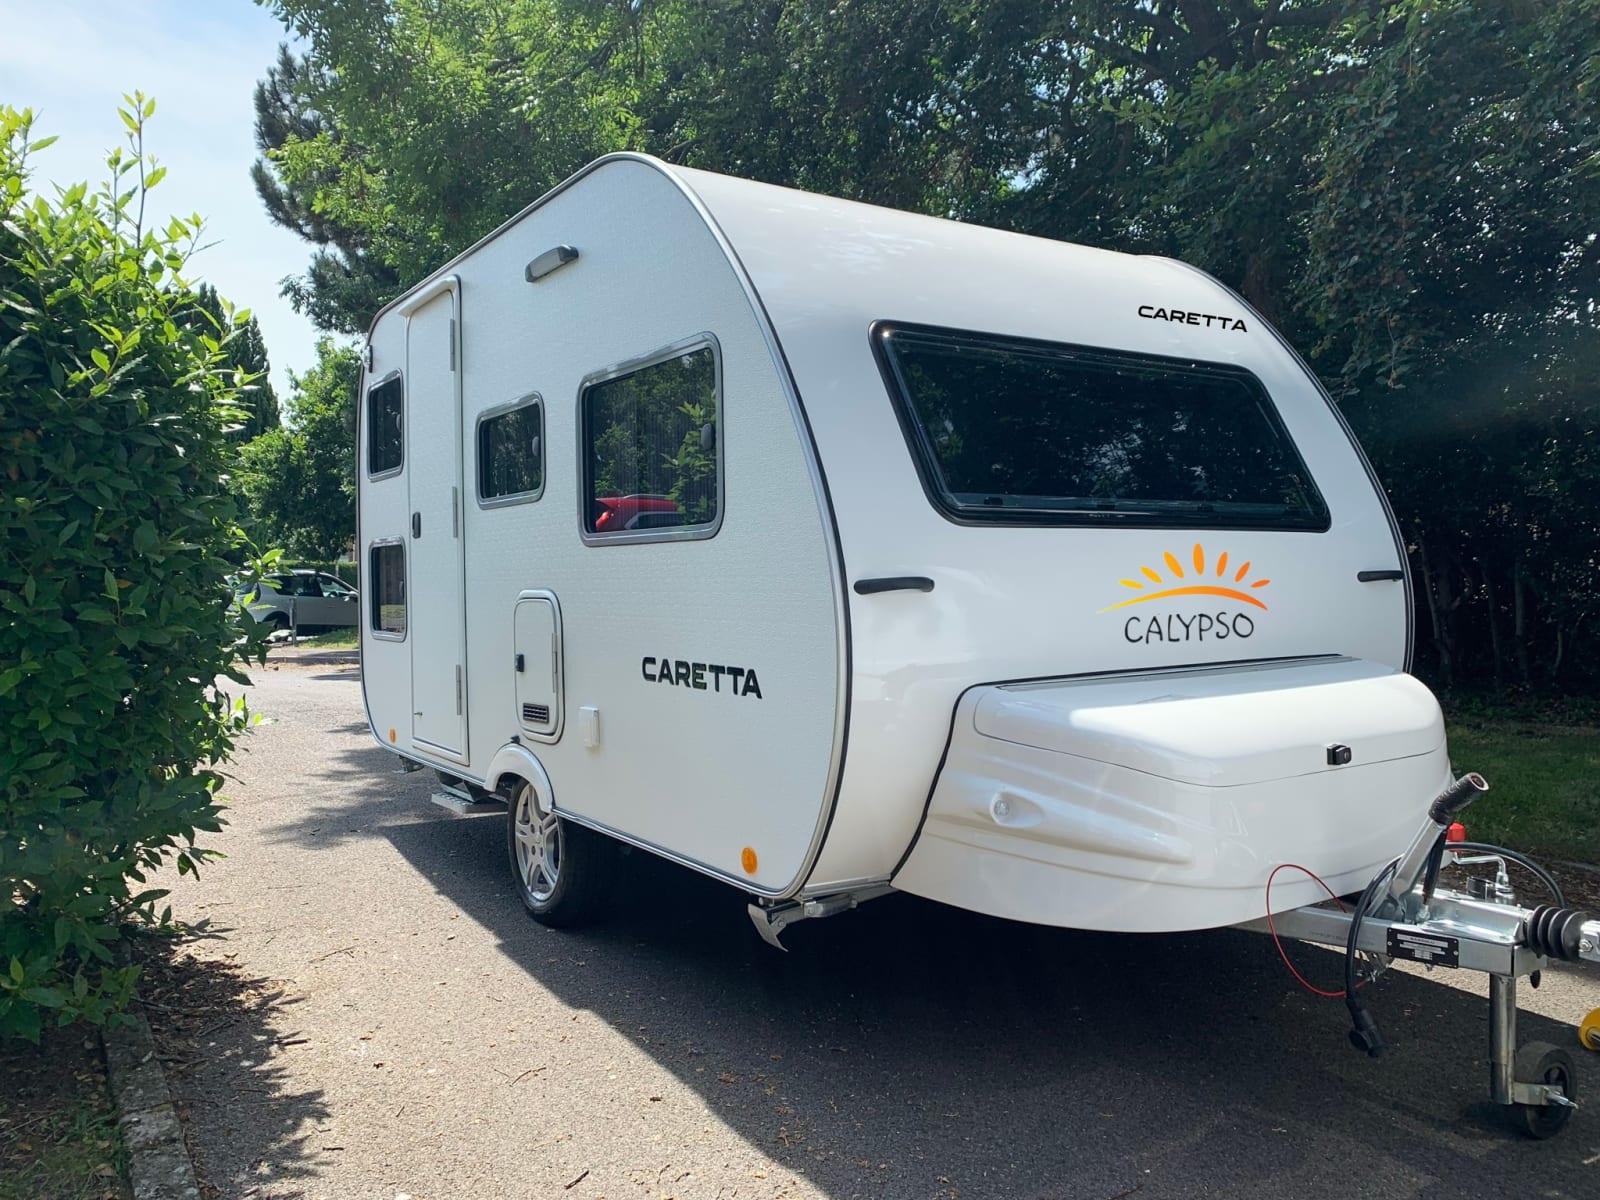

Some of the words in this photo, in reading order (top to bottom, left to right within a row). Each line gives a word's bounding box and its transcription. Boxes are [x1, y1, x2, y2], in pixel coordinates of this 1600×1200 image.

[1138, 305, 1248, 333] CARETTA
[1124, 611, 1255, 645] CALYPSO
[642, 656, 763, 700] CARETTA
